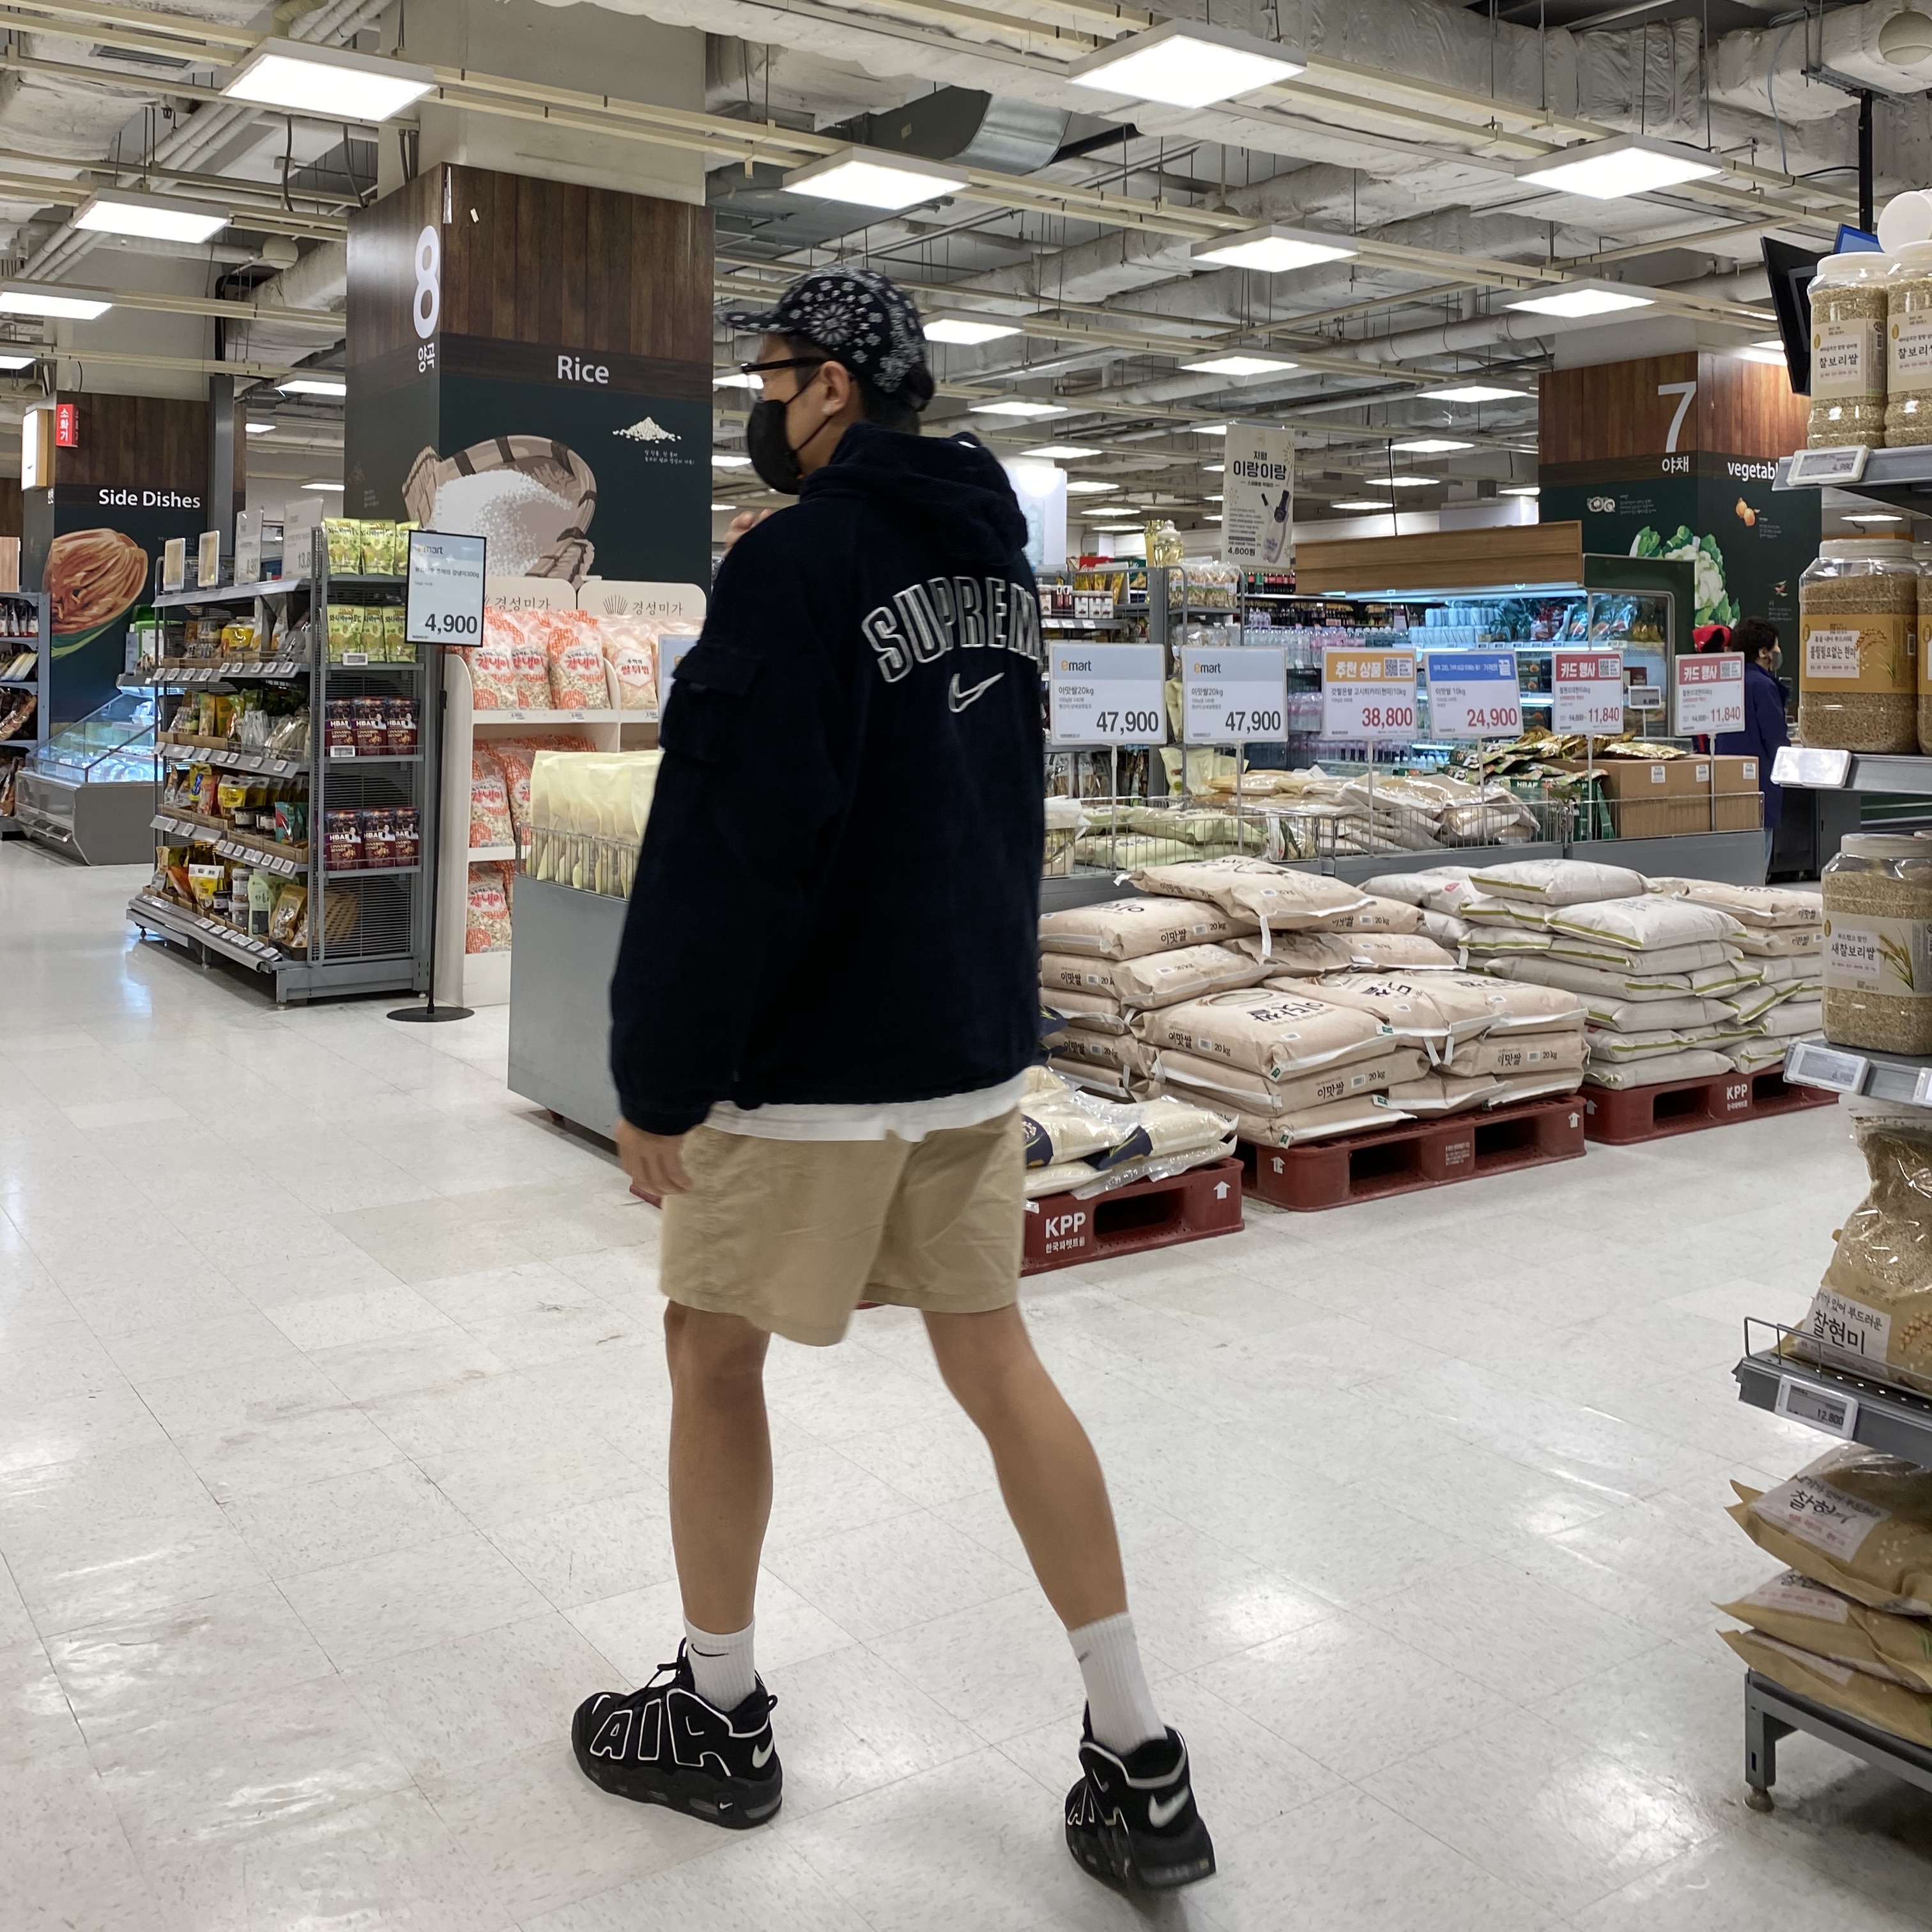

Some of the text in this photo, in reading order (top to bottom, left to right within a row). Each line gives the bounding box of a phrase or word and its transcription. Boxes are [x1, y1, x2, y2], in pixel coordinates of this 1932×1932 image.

[413, 225, 440, 339] 8
[418, 342, 436, 373] 양곡
[1820, 353, 1859, 369] 찰보리쌀
[1898, 345, 1932, 360] 찰보리
[557, 355, 610, 384] Rice
[59, 408, 69, 441] 소화기
[1658, 381, 1697, 453] 7
[1233, 461, 1287, 480] 이랑이랑
[1662, 455, 1689, 474] 야채
[98, 489, 201, 509] Side Dishes
[494, 595, 551, 611] 경성미가
[632, 601, 684, 617] 경성미가
[425, 613, 478, 635] 4,900
[478, 656, 510, 671] 강냉이
[512, 656, 544, 670] 강냉이
[567, 656, 599, 670] 강냉이
[1061, 660, 1092, 671] emart
[1194, 663, 1222, 673] emart
[1335, 661, 1357, 678] 추천
[1360, 661, 1381, 678] 상품
[1561, 662, 1595, 678] 카드 행사
[1684, 665, 1717, 681] 카드 행사
[1059, 686, 1094, 696] 이맛쌀20kg
[1192, 687, 1223, 697] 이맛쌀20kg
[1096, 711, 1159, 735] 47,900
[1225, 710, 1281, 734] 47,900
[1362, 707, 1413, 729] 38,800
[1467, 708, 1517, 729] 24,900
[1588, 707, 1620, 724] 11,840
[1711, 706, 1741, 723] 11,840
[471, 790, 503, 803] 강냉이
[1160, 883, 1184, 894] 이맛쌀
[468, 893, 503, 908] 강냉이
[1383, 917, 1390, 926] kg
[1798, 909, 1816, 920] 이맛쌀
[1218, 922, 1227, 931] kg
[1160, 928, 1187, 945] 이맛쌀
[1831, 942, 1876, 961] 새찰보리쌀
[1061, 972, 1082, 986] 이맛쌀
[1064, 1041, 1085, 1055] 이맛쌀
[1168, 1031, 1193, 1050] 이맛쌀
[1214, 1043, 1231, 1057] 20 kg
[1550, 1050, 1558, 1060] kg
[1498, 1053, 1521, 1066] 이맛쌀
[1368, 1070, 1386, 1082] 20 kg
[1317, 1081, 1345, 1100] 이맛쌀
[1726, 1083, 1748, 1100] KPP
[1045, 1212, 1086, 1239] KPP
[1046, 1236, 1085, 1254] 한국파렛트풀
[1848, 1307, 1883, 1331] 부드러운
[1813, 1309, 1865, 1354] 찰현미
[589, 1687, 732, 1777] AIR
